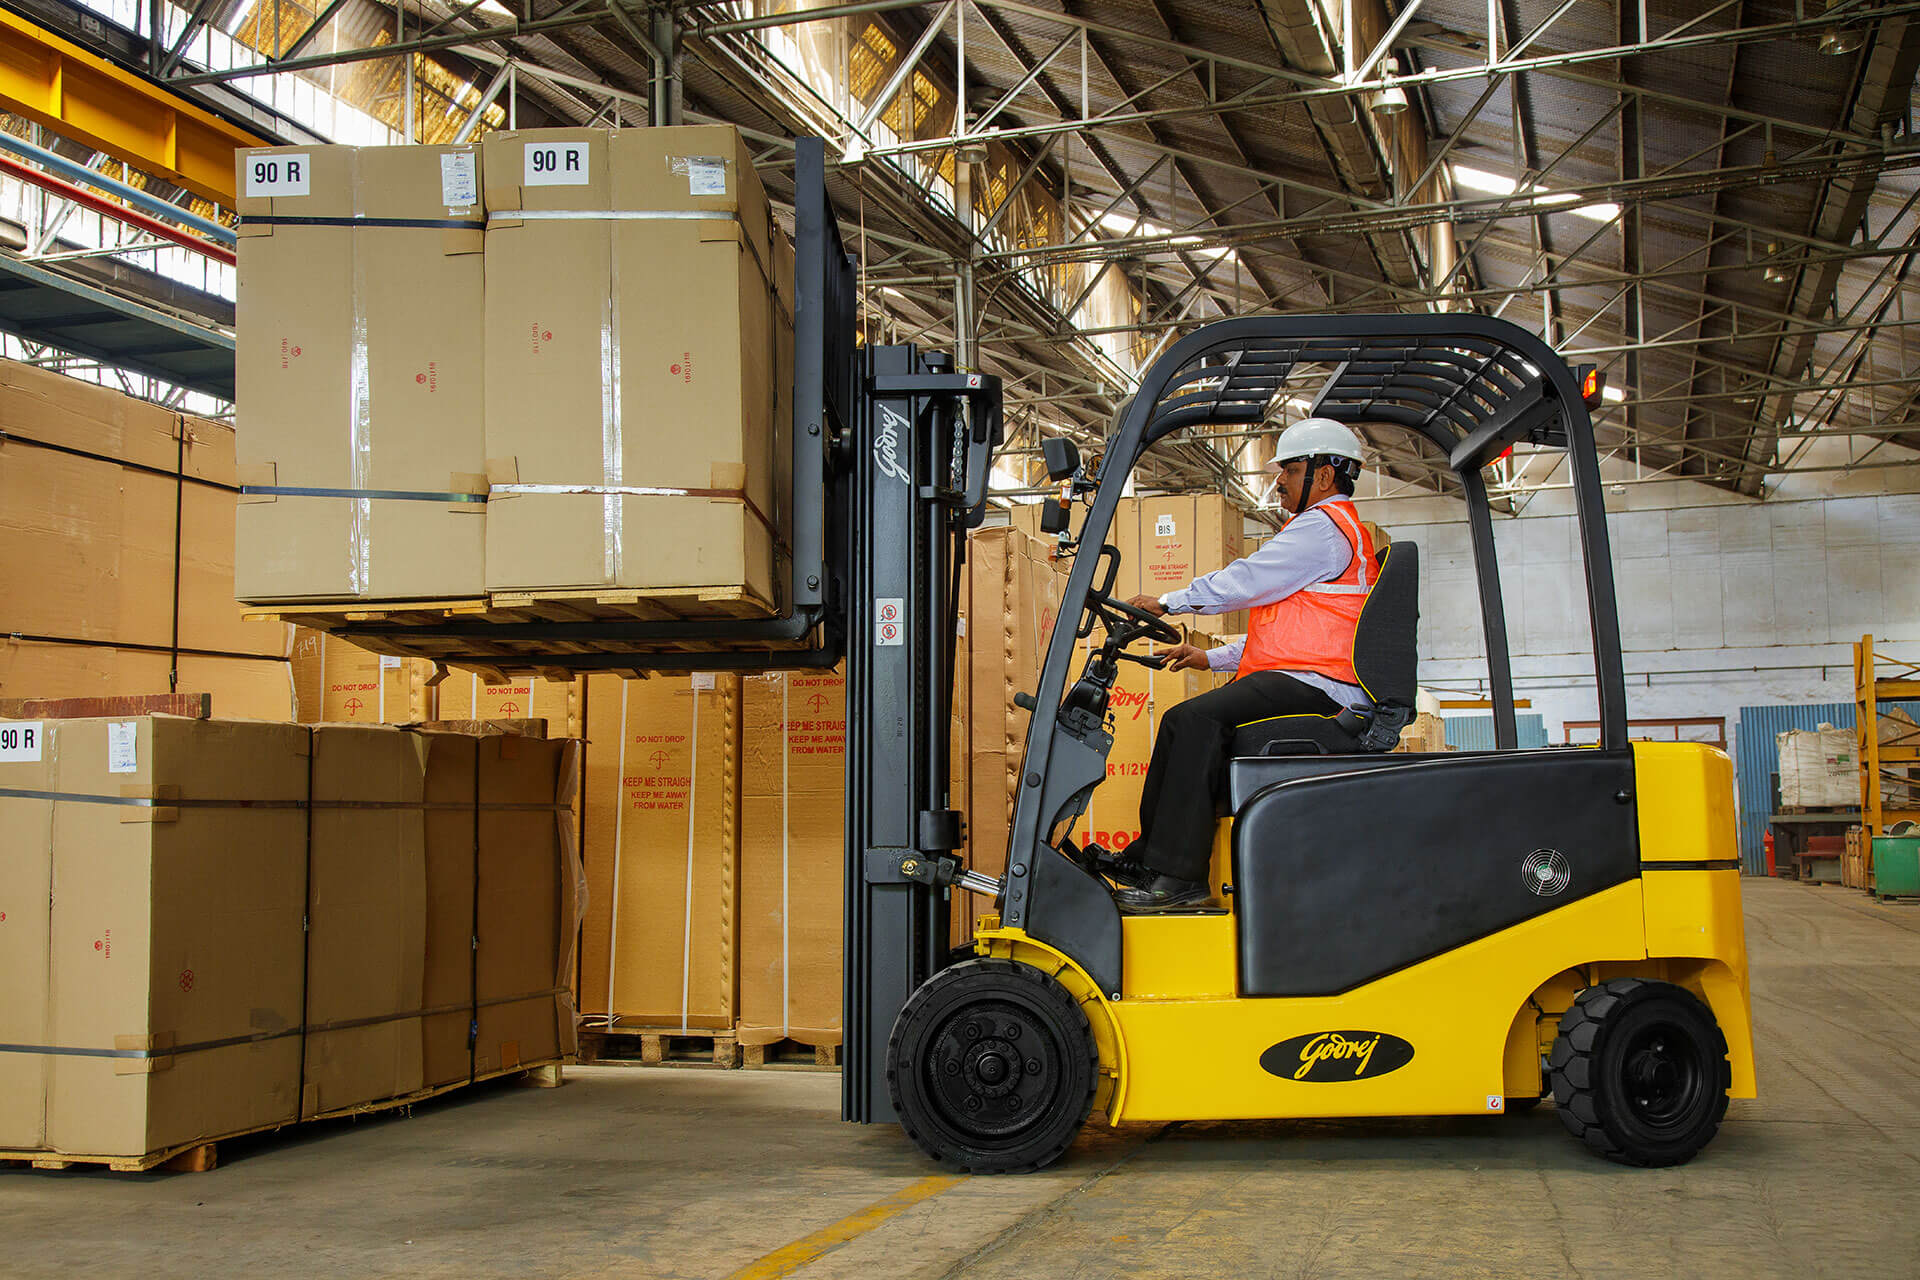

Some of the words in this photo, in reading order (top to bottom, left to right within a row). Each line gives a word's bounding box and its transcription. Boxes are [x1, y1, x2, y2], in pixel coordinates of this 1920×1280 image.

[533, 150, 556, 172] 90
[566, 150, 580, 171] R
[254, 162, 278, 183] 90
[287, 161, 301, 182] R
[873, 403, 911, 485] Godrej
[1158, 525, 1171, 535] BIS
[793, 679, 804, 687] DO
[806, 679, 820, 687] NOT
[823, 678, 844, 686] DROP
[1108, 686, 1150, 720] odrej
[802, 721, 814, 731] ME
[816, 720, 846, 731] STRAIG
[1, 729, 18, 749] 90
[24, 729, 35, 749] R
[788, 735, 809, 743] KEEP
[811, 735, 823, 743] ME
[824, 735, 846, 743] AWAY
[792, 746, 815, 754] FROM
[816, 745, 844, 754] WATER
[623, 776, 643, 787] KEEP
[645, 776, 656, 787] ME
[657, 776, 692, 787] STRAIGH
[631, 791, 651, 799] KEEP
[653, 791, 664, 799] ME
[666, 791, 687, 799] AWAY
[657, 801, 684, 809] WATER
[1293, 1033, 1381, 1080] Godrej
